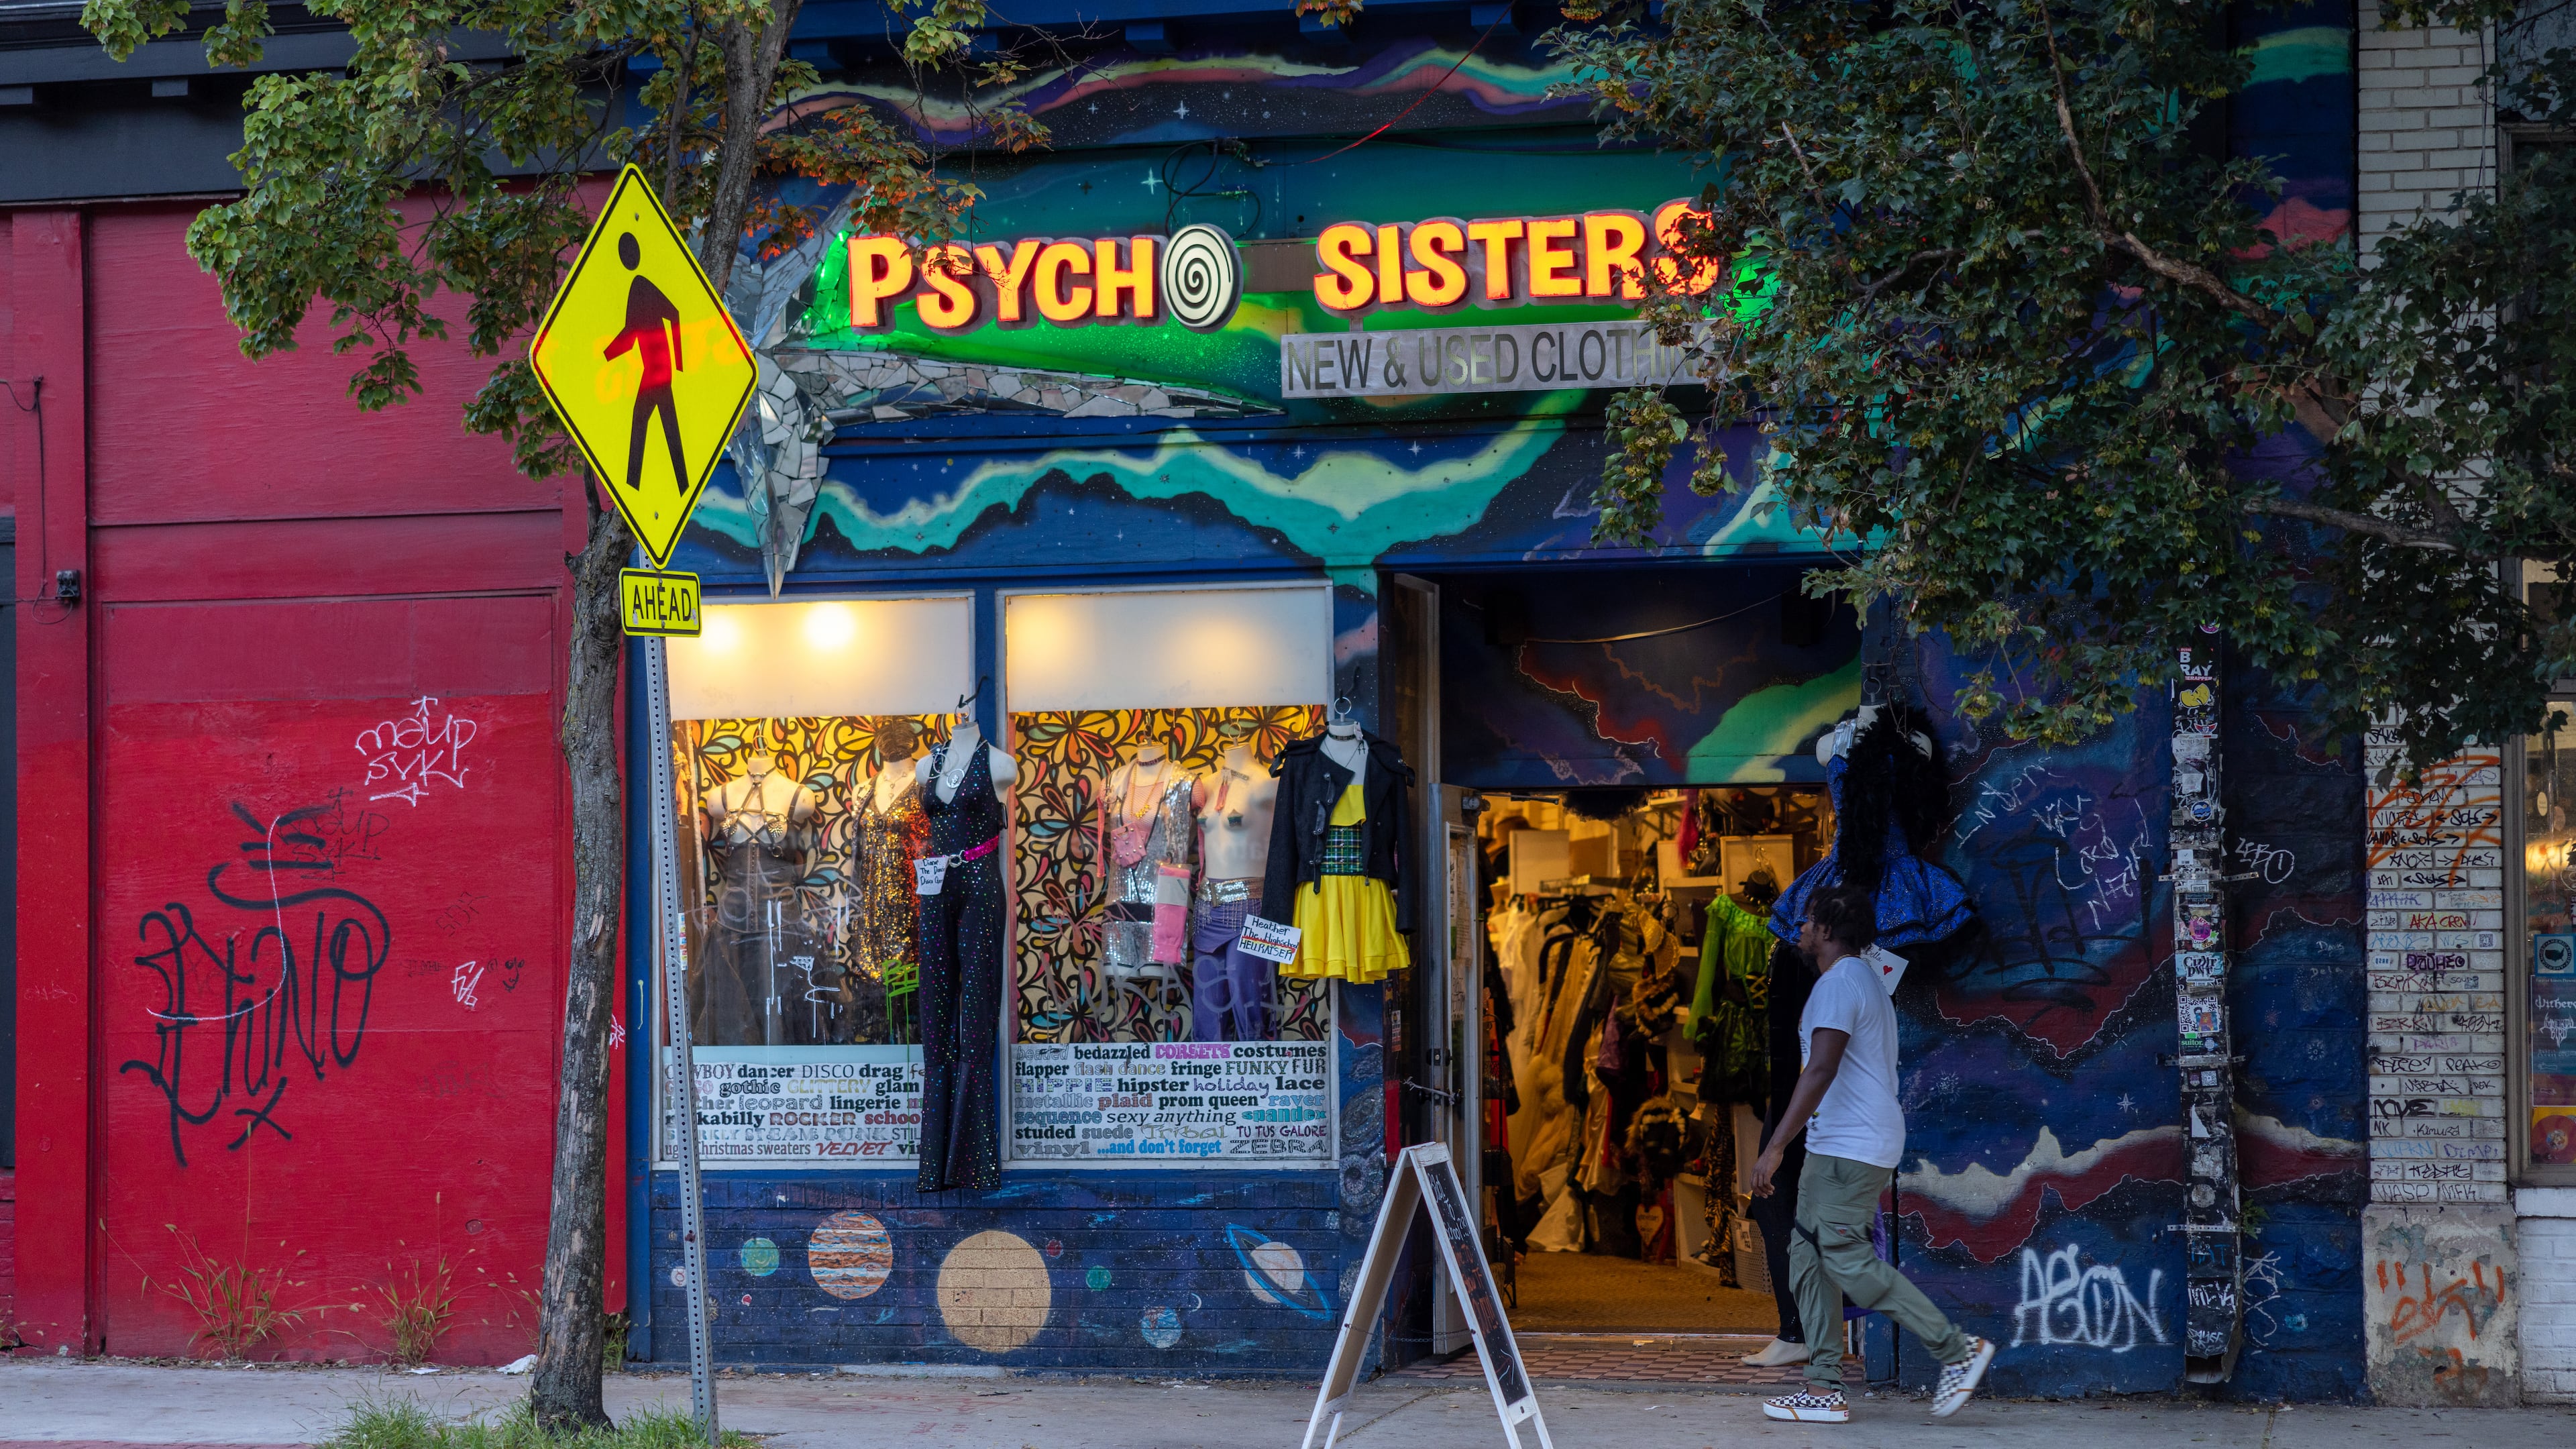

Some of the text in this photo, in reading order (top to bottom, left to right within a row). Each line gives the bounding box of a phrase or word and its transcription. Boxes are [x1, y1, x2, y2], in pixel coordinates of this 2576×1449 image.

[1313, 201, 1720, 310] SISTERS
[1287, 338, 1373, 391] NEW
[1383, 337, 1408, 388] &
[1418, 333, 1519, 387] USED
[633, 584, 692, 621] AHEAD
[1243, 926, 1259, 938] The
[1251, 917, 1291, 936] Heather
[1016, 1044, 1327, 1060] beaded bedazzled CORSETS costumes
[665, 1063, 736, 1079] CWBOY
[737, 1064, 795, 1078] dancer
[802, 1064, 854, 1079] DISCO
[859, 1063, 904, 1081] drag
[1015, 1058, 1326, 1078] flapper flash dance fringe FUNKY FUR
[720, 1079, 781, 1097] gothic
[788, 1079, 871, 1093] GLITTERY
[875, 1079, 920, 1096] glam
[1014, 1075, 1326, 1099] HIPPIE hipster holiday lace
[739, 1094, 823, 1110] leopard
[829, 1095, 901, 1113] lingerie
[1014, 1092, 1326, 1111] metallic plaid prom queen raver
[665, 1110, 922, 1128] rkabilly ROCKER schoo
[1014, 1106, 1326, 1127] sequence sexy anything spandex
[745, 1128, 818, 1142] STEAM
[824, 1127, 888, 1141] PUNK
[1015, 1123, 1327, 1139] studed suede Tribal TU TUS GALORE
[757, 1142, 811, 1155] sweaters
[815, 1140, 893, 1156] VELVET
[1016, 1141, 1090, 1157] vinyl
[1138, 1139, 1175, 1154] don't
[1179, 1139, 1222, 1157] forget
[1230, 1139, 1327, 1154] ZEBRA
